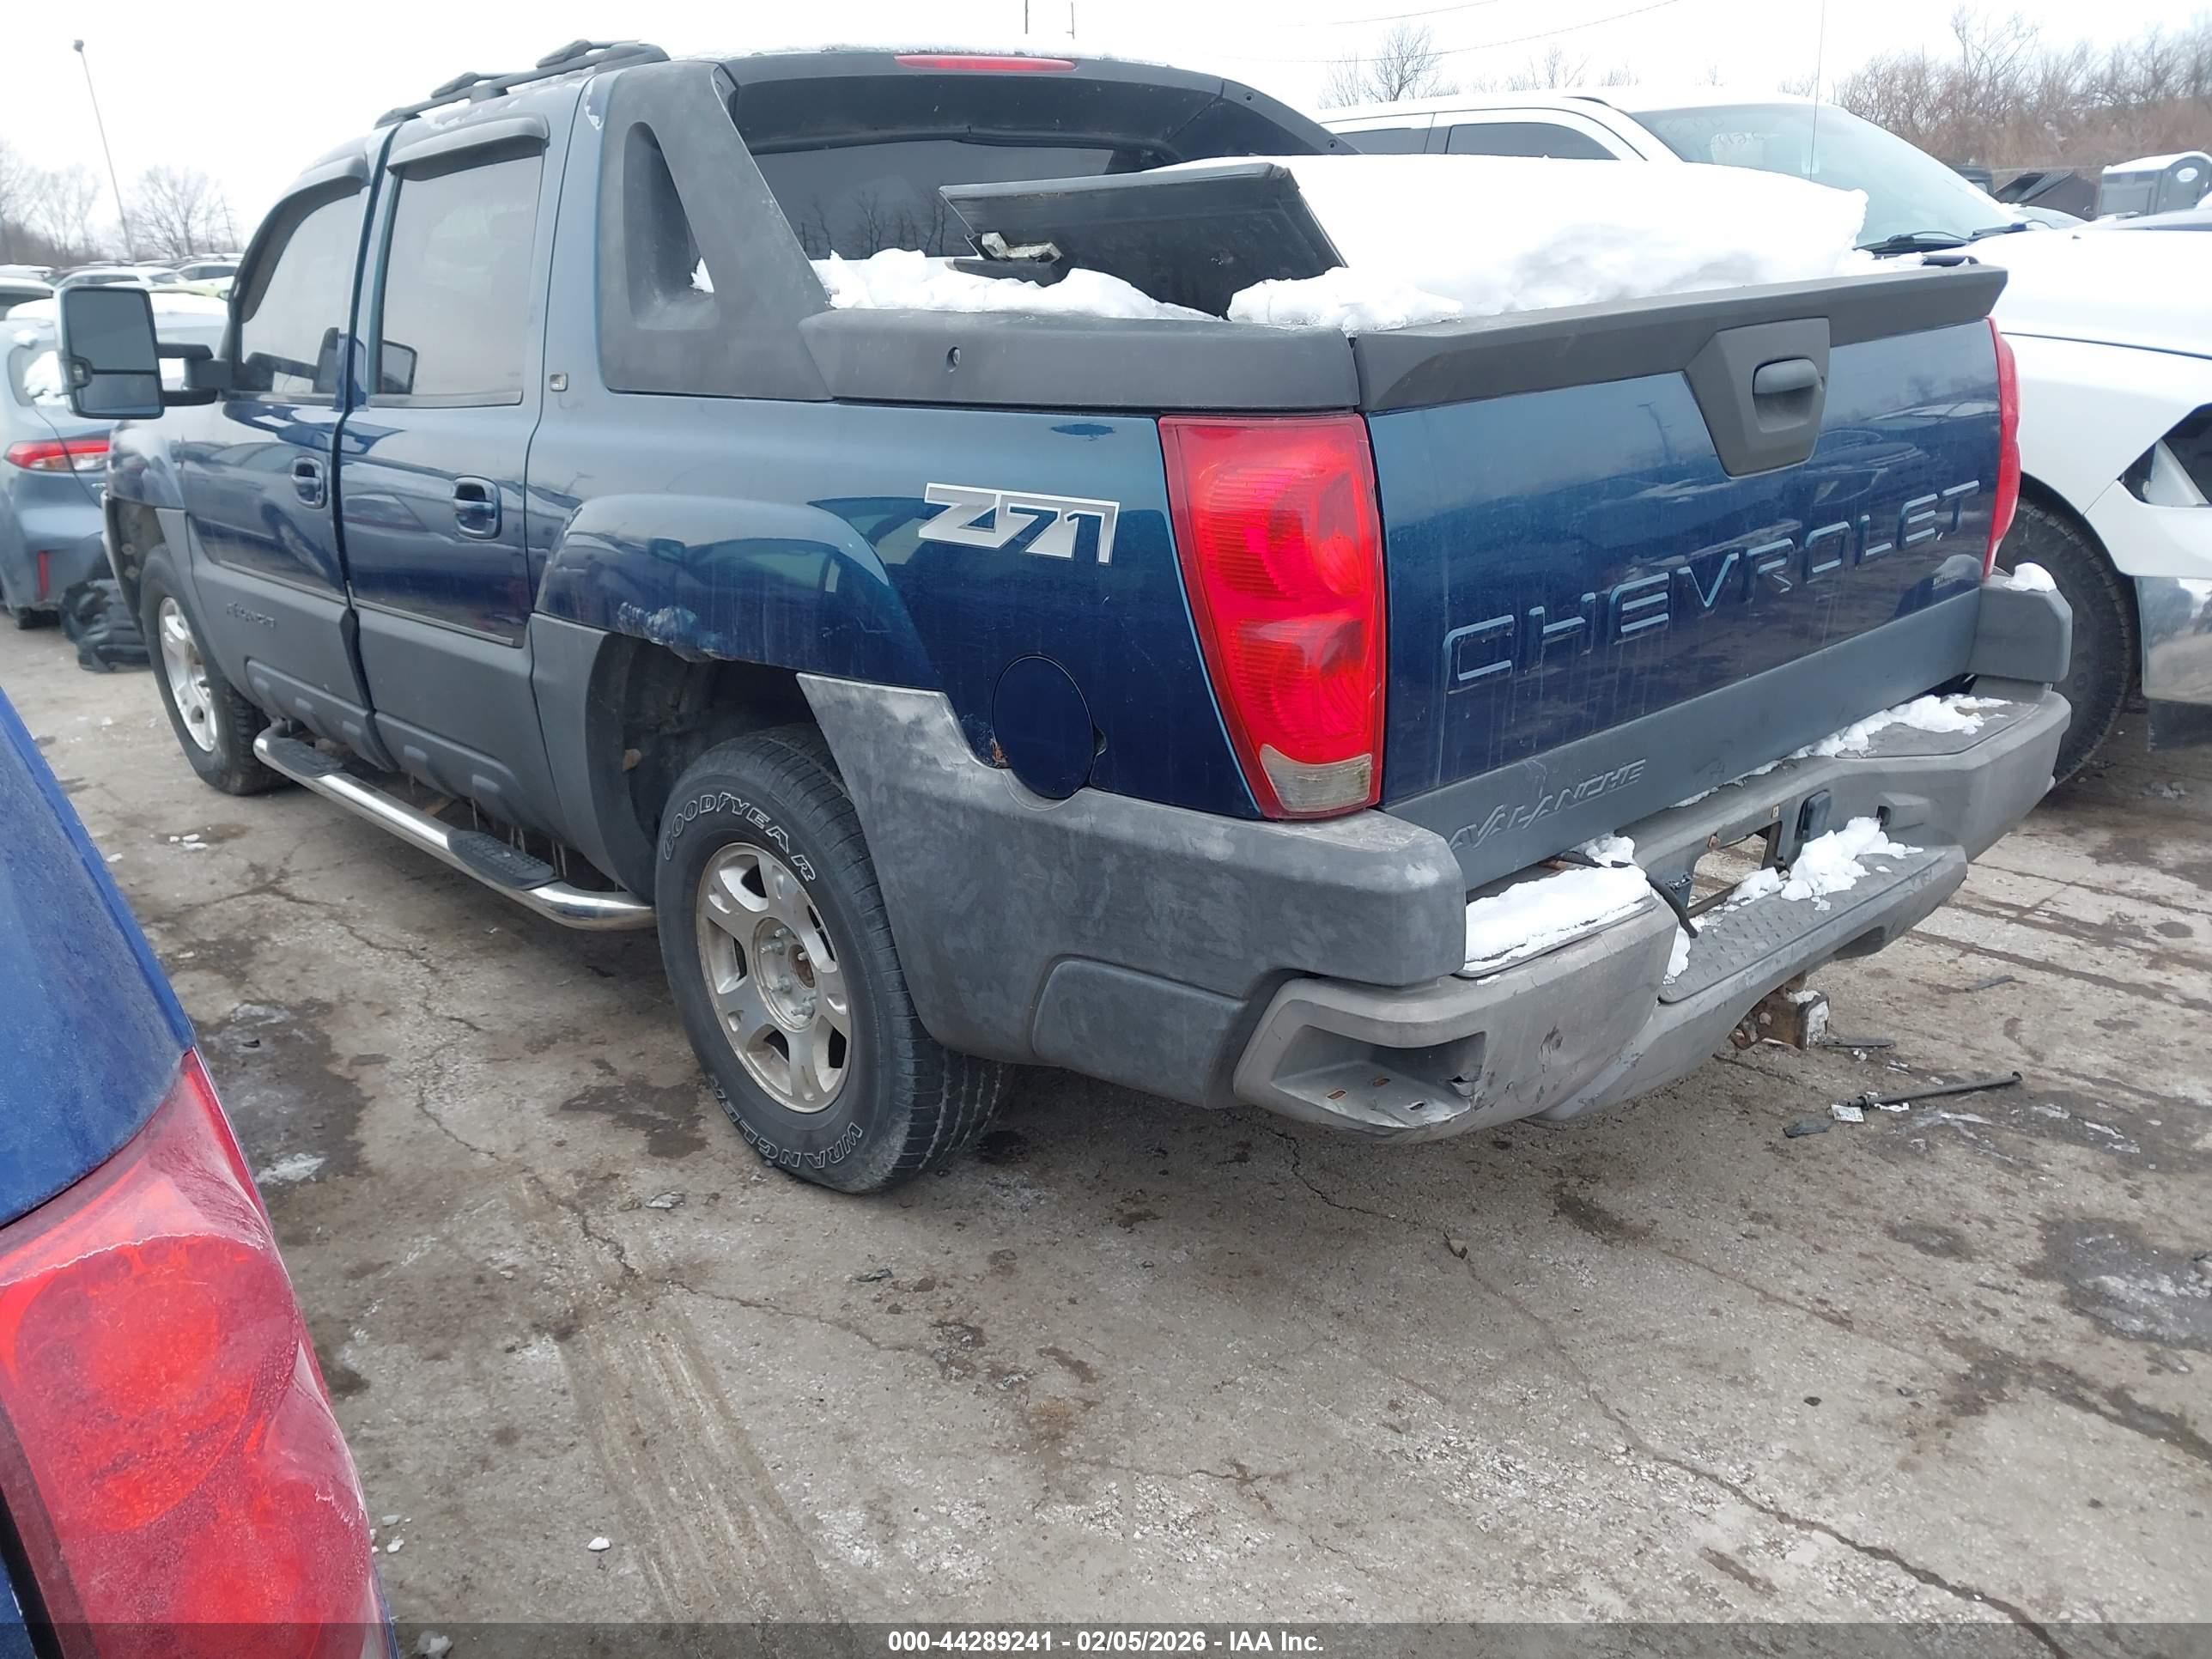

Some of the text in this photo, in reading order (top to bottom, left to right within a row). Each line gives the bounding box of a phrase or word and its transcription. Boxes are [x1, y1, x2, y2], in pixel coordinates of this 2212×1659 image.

[919, 483, 1120, 566] Z71
[1442, 479, 1980, 694] CHEVROLET
[663, 791, 817, 884] GOODYEAR
